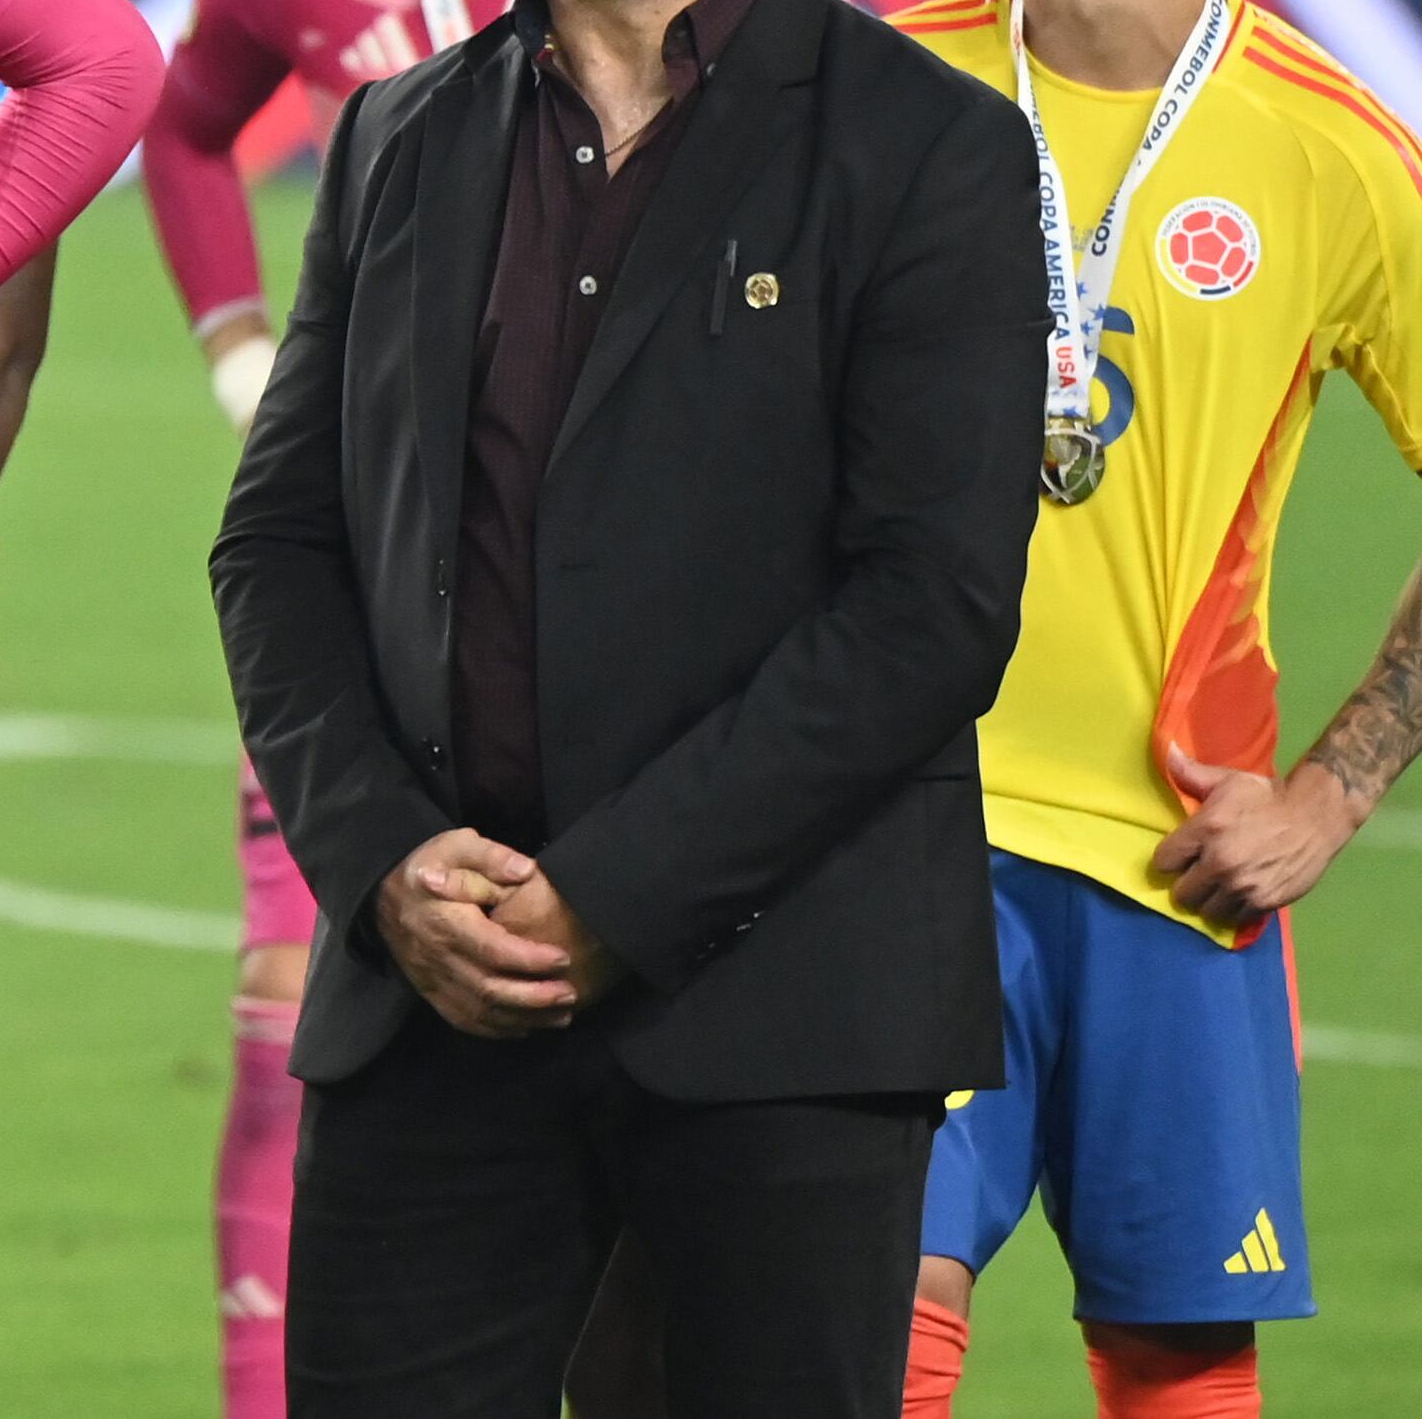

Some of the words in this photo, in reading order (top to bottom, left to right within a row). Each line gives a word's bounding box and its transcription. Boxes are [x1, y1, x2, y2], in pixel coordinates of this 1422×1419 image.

[1142, 99, 1178, 151] COPA
[1040, 172, 1058, 231] COPA
[1045, 240, 1070, 340] AMERICA
[1056, 347, 1076, 388] USA
